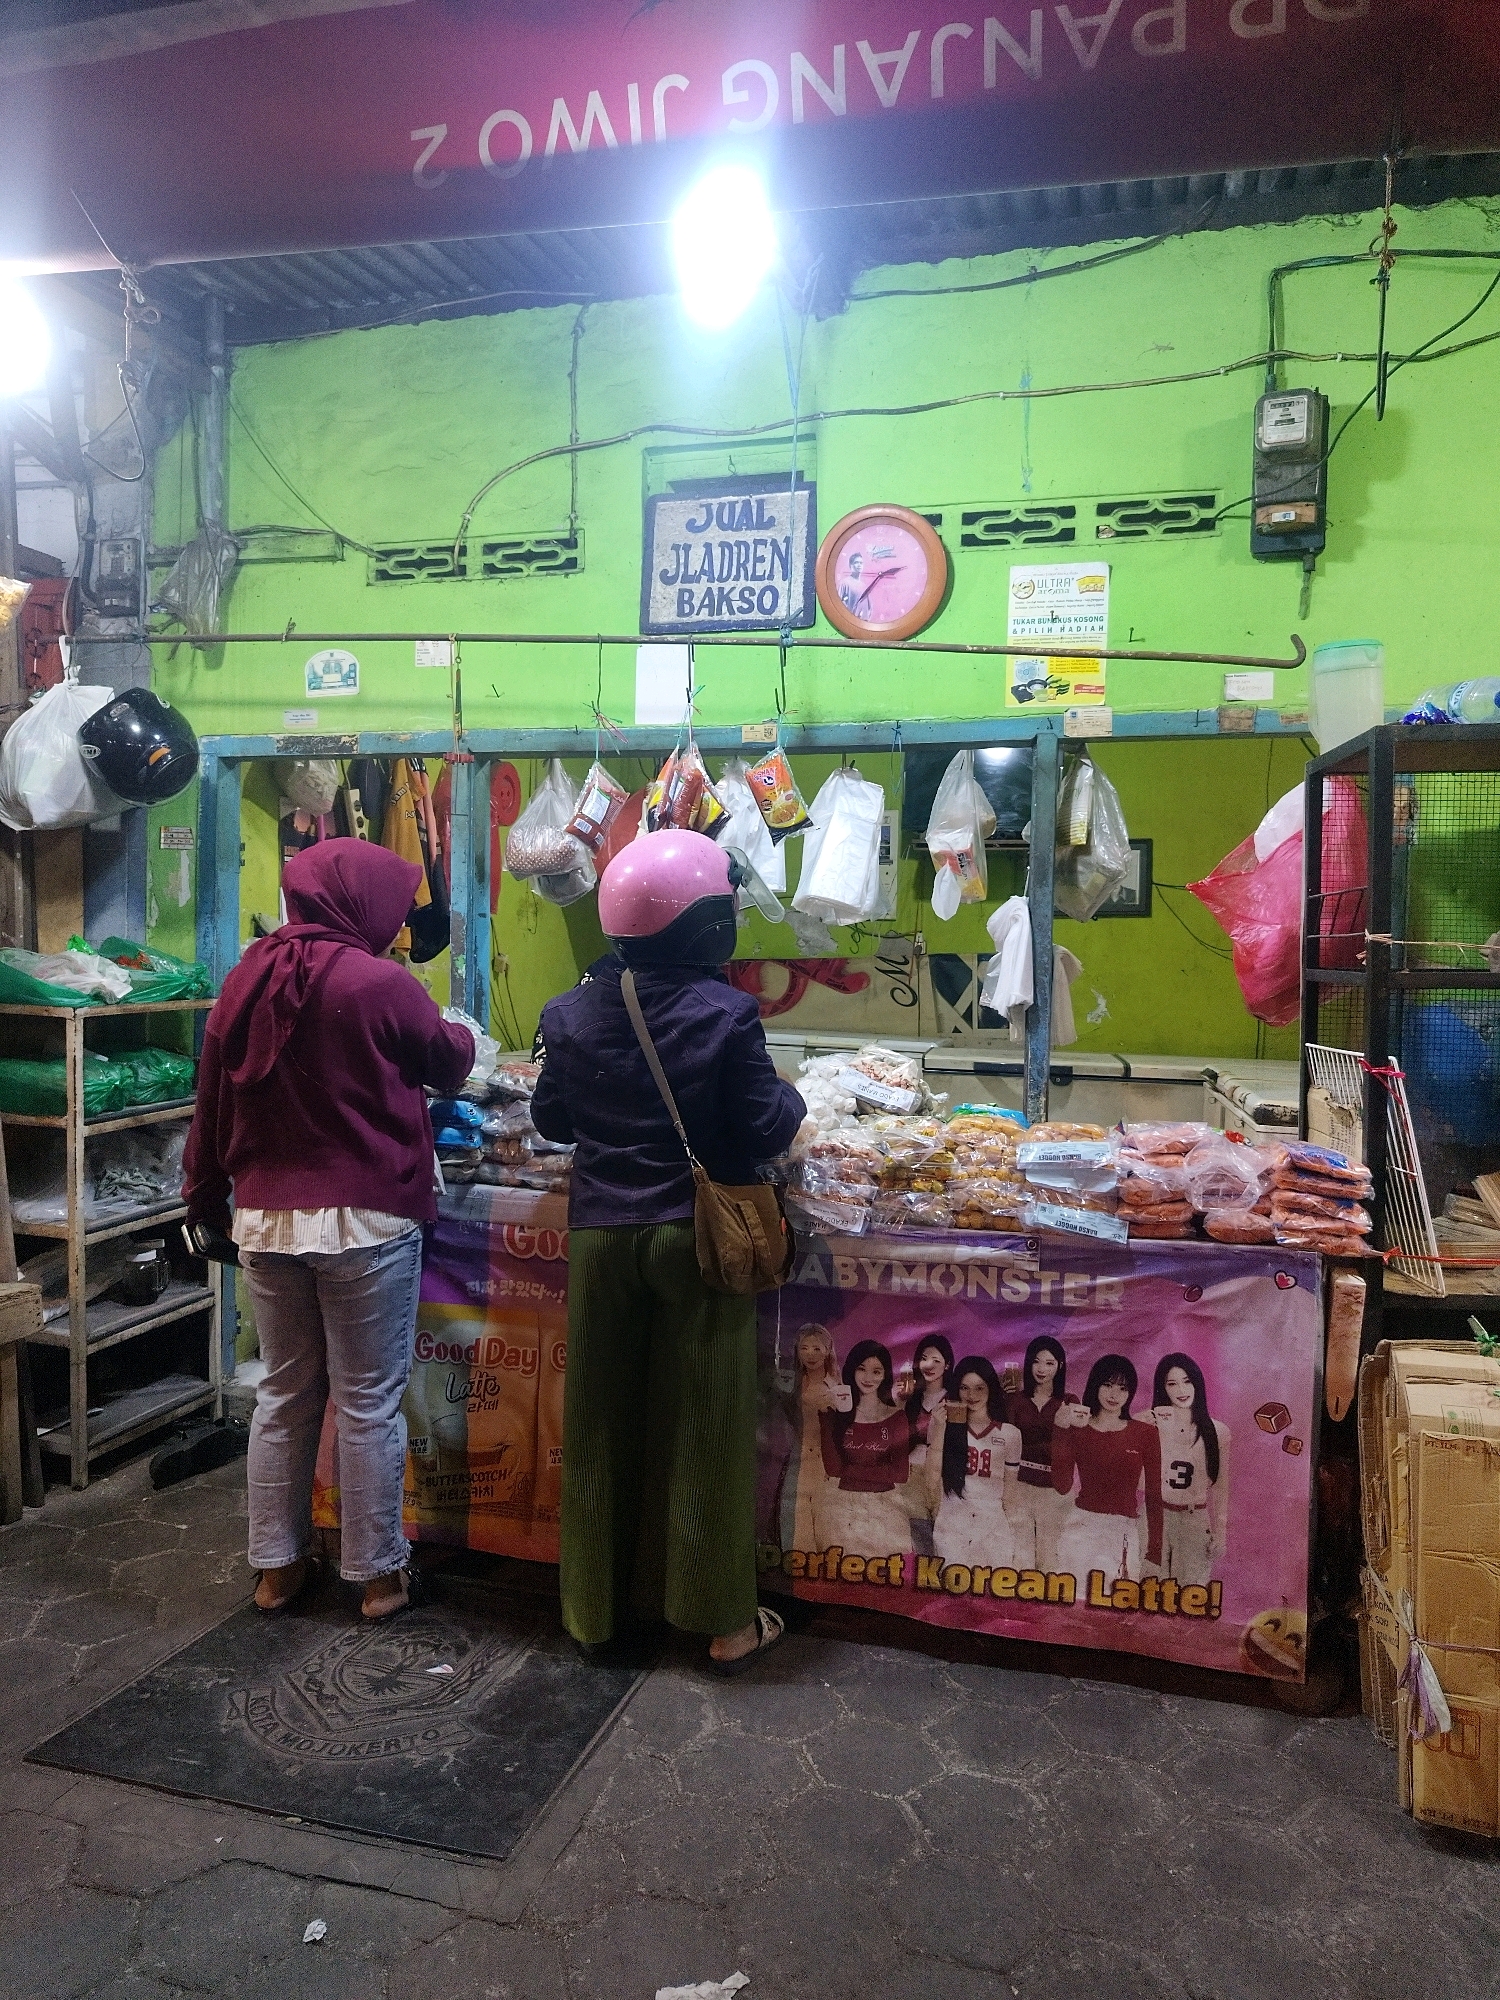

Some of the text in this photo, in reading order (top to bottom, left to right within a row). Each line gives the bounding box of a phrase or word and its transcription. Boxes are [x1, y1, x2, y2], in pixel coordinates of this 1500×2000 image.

[722, 0, 1188, 134] PANJANG
[478, 74, 690, 179] JIWO
[410, 124, 448, 190] 2
[685, 499, 776, 533] JUAL
[659, 535, 792, 586] JLADREN
[1037, 577, 1071, 589] ULTRA
[676, 584, 780, 618] BAKSO
[1012, 617, 1036, 626] TUKAR
[1073, 615, 1104, 623] KOSONG
[1020, 626, 1053, 635] PILIH
[1059, 624, 1104, 634] HADIAH
[1054, 1220, 1098, 1236] BAKSO NUGGET
[786, 1252, 1127, 1311] ABYMONSTER
[414, 1330, 485, 1366] Good
[485, 1335, 540, 1379] Day
[446, 1370, 501, 1403] Latte
[467, 1400, 499, 1413] 라떼
[409, 1437, 428, 1447] NEW
[425, 1468, 508, 1487] BUTTERSCOTCH
[1169, 1460, 1195, 1489] 3
[757, 1543, 1224, 1618] Perfect Korean Latte!
[277, 1728, 440, 1757] MOJOKERTO
